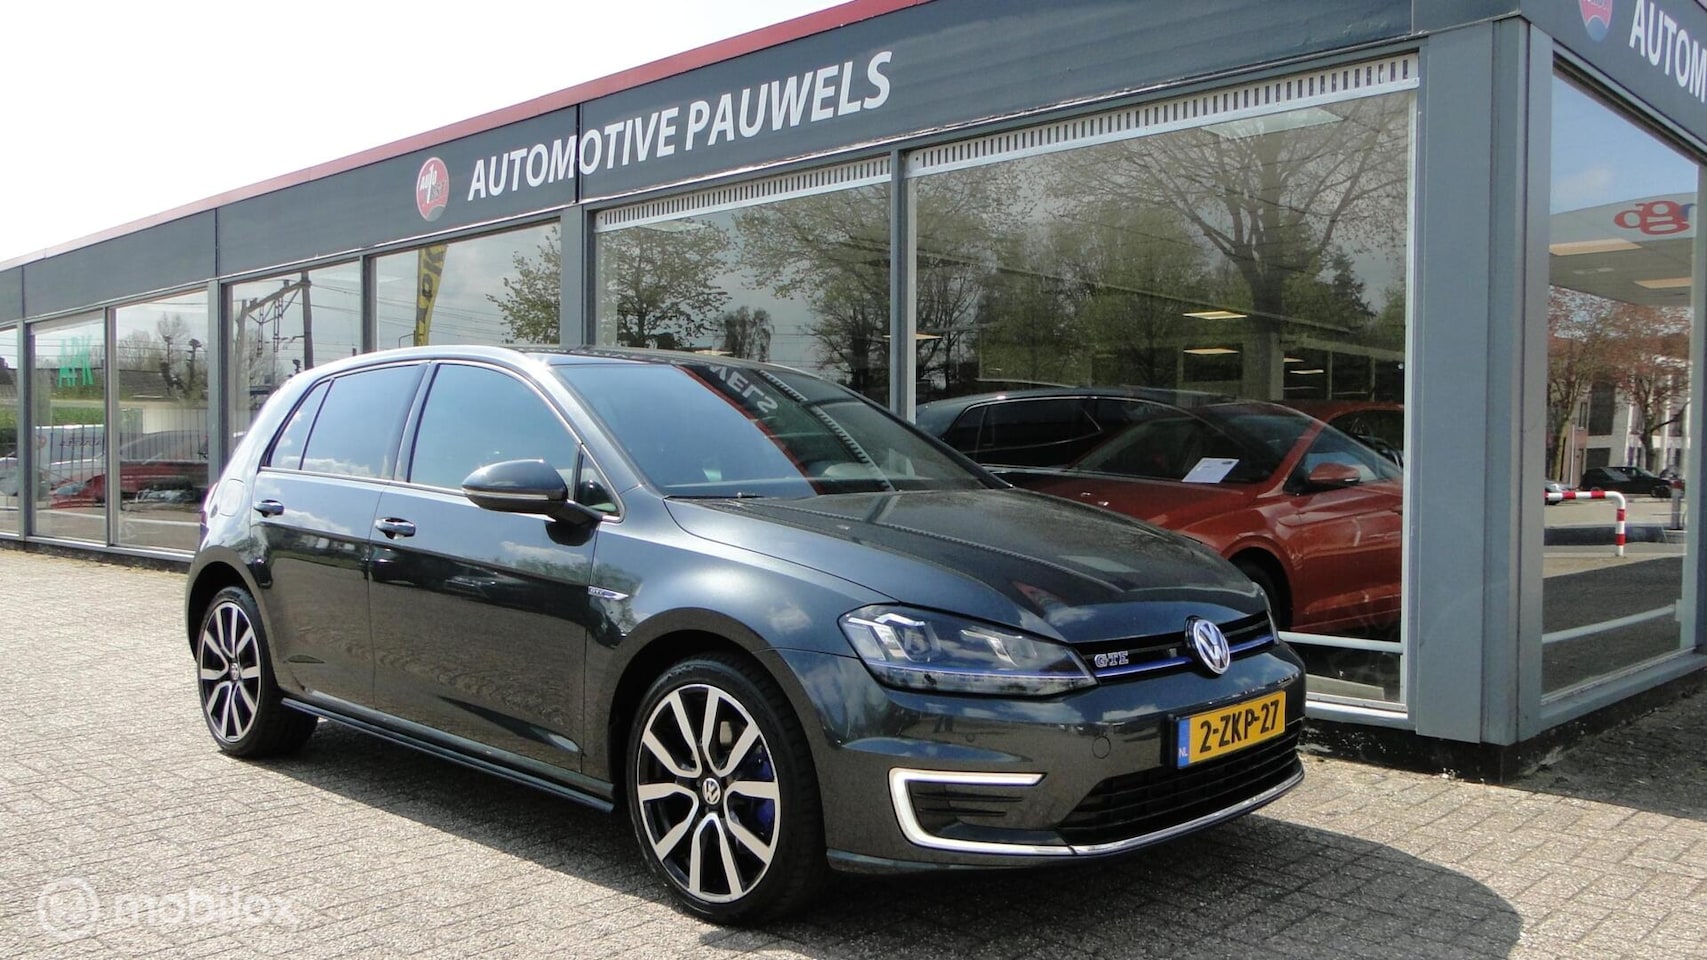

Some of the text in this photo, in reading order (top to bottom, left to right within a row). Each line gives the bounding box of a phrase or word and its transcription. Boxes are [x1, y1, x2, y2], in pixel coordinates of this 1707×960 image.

[467, 50, 893, 201] AUTOMOTIVE PAUWELS
[1094, 651, 1129, 668] GTE
[1199, 700, 1280, 754] 2-ZKP-27
